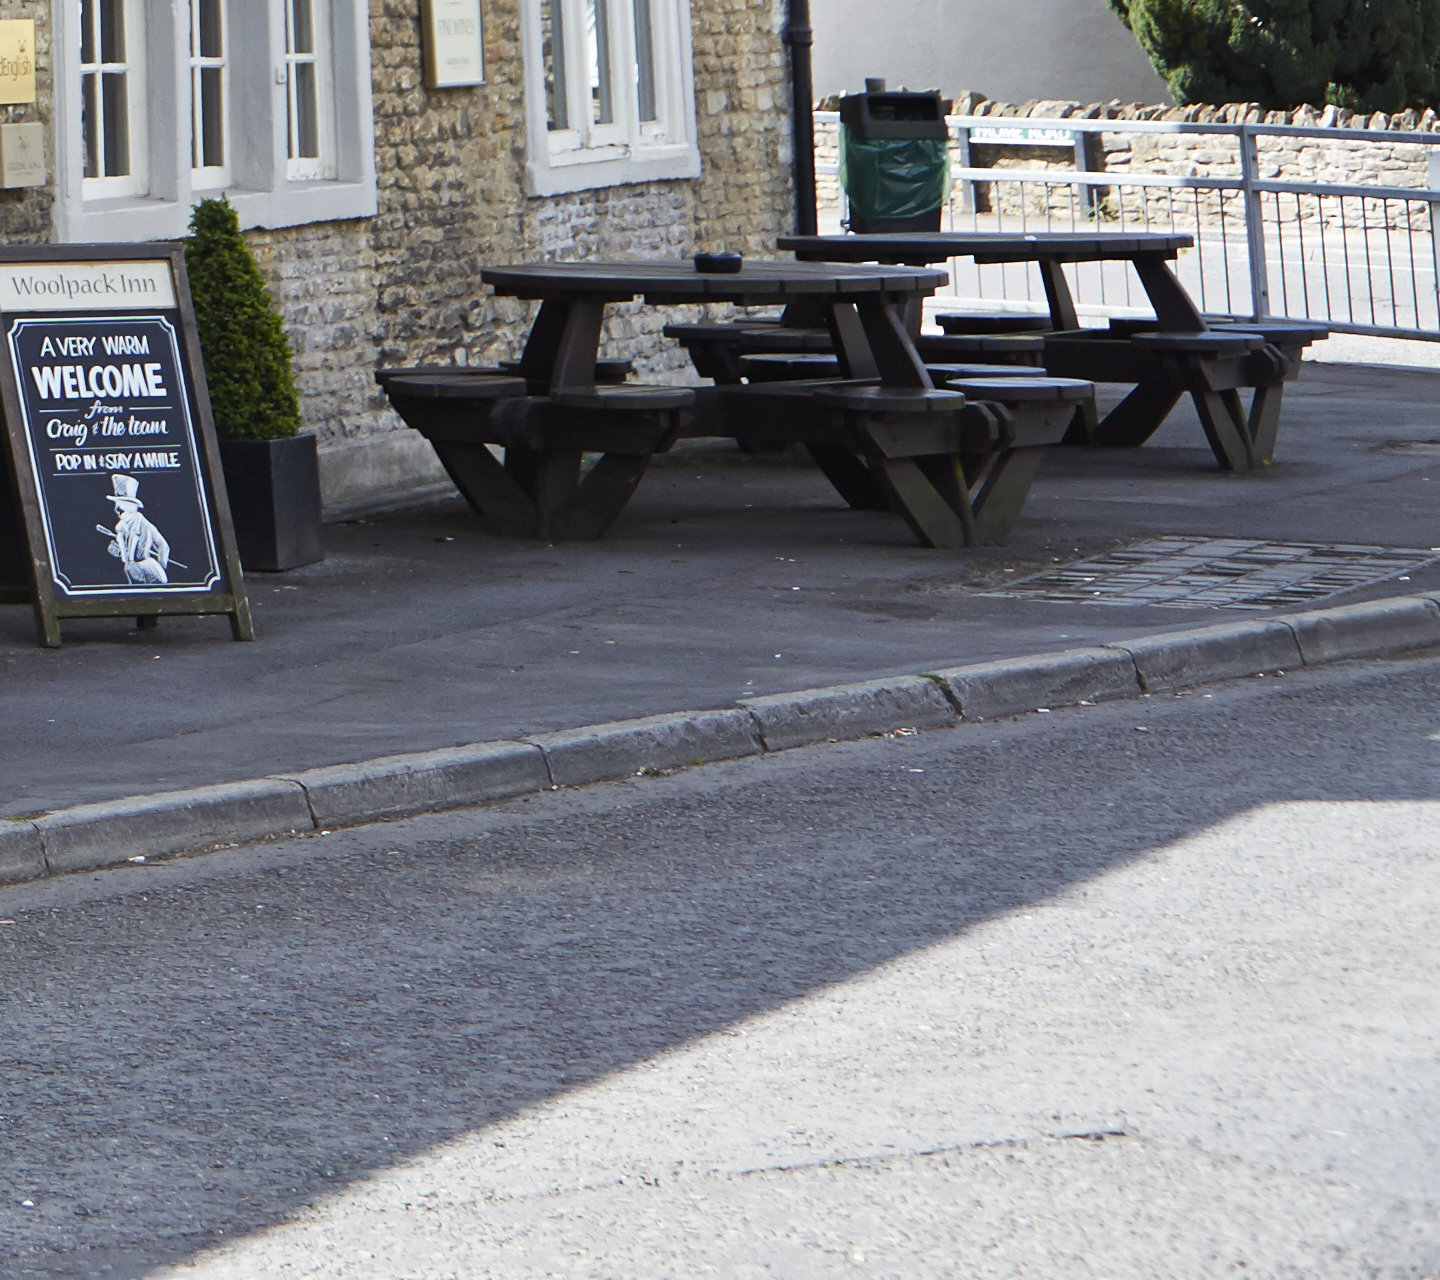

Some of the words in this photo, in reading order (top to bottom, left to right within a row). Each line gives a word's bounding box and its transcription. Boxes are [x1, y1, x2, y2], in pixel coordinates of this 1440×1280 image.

[12, 273, 117, 299] Woolpack
[121, 274, 157, 293] Inn
[40, 336, 56, 358] A
[56, 336, 96, 357] VERY
[102, 335, 150, 356] WARM
[31, 362, 168, 399] WELCOME
[84, 399, 124, 419] from
[46, 418, 88, 447] Craig
[100, 415, 126, 436] the
[128, 414, 169, 436] team
[55, 453, 82, 471] POP
[82, 454, 98, 470] IN
[104, 452, 132, 470] STAY
